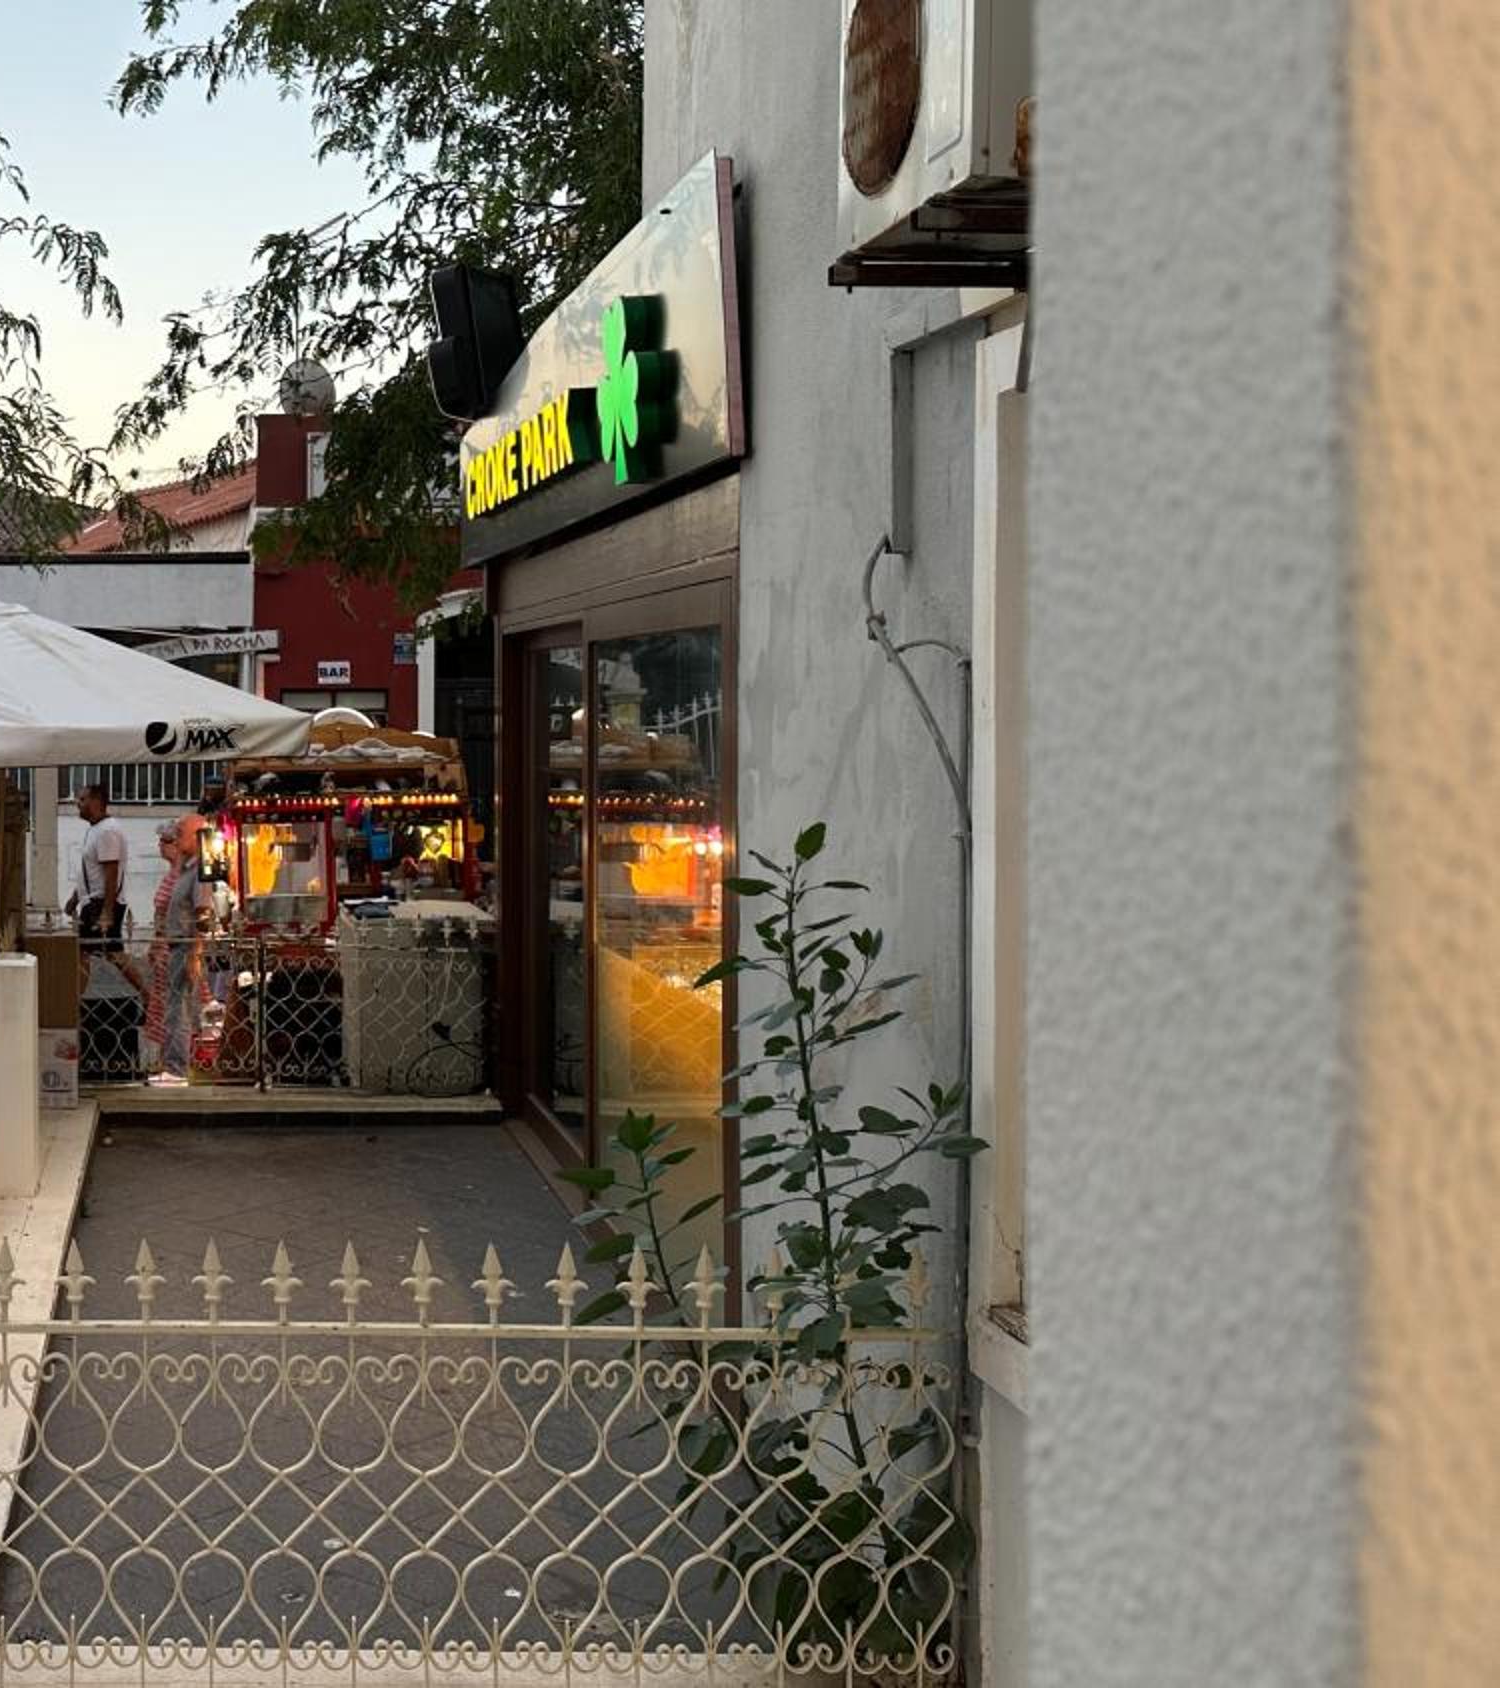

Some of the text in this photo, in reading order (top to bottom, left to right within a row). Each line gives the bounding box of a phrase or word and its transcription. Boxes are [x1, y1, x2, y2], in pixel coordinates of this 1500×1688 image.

[466, 389, 575, 520] CROKE PARK
[318, 667, 349, 678] BAR
[184, 726, 241, 752] MAX
